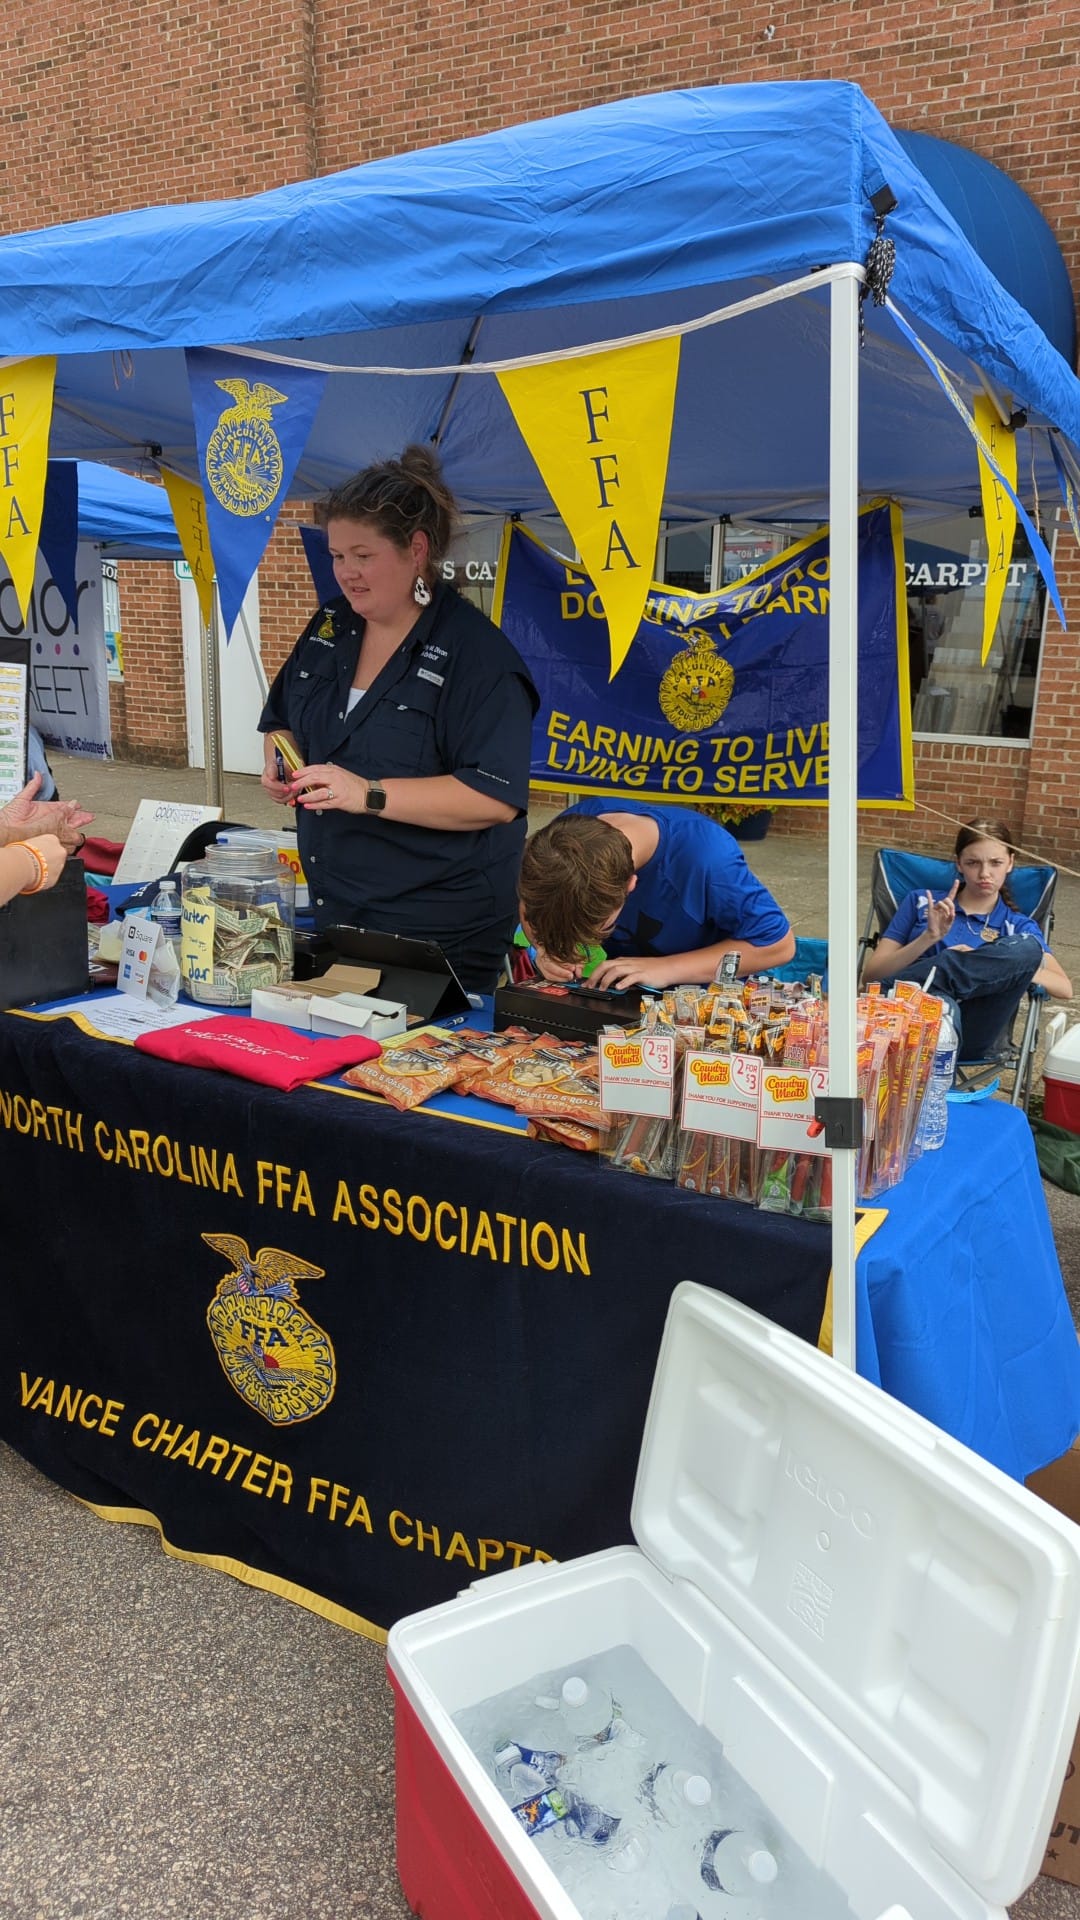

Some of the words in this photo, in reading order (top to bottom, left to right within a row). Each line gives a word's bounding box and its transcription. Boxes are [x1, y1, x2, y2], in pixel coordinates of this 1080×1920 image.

[233, 439, 261, 465] FFA
[0, 393, 32, 539] FFA
[579, 386, 641, 571] FFA
[466, 561, 497, 580] CA
[904, 563, 1026, 586] CARPT
[685, 675, 716, 688] FFA
[547, 711, 700, 764] EARNING
[710, 736, 754, 763] TO
[547, 741, 650, 787] LIVING
[661, 765, 704, 792] TO
[135, 930, 153, 944] Square
[606, 1044, 640, 1057] Country
[648, 1041, 655, 1056] 2
[614, 1054, 640, 1065] Meats
[658, 1054, 668, 1069] $3
[737, 1059, 744, 1076] 2
[746, 1064, 757, 1073] FOR
[692, 1060, 729, 1076] Country
[700, 1073, 727, 1084] Meats
[746, 1074, 757, 1090] $3
[767, 1076, 805, 1092] Country
[817, 1073, 825, 1089] 2
[775, 1088, 805, 1099] Meats
[570, 1097, 600, 1107] ROAST
[727, 1099, 757, 1109] SUPPORTING
[763, 1110, 780, 1118] THANK
[0, 1090, 84, 1153] NORTH
[94, 1120, 244, 1198] CAROLINA
[256, 1160, 317, 1217] FFA
[332, 1180, 592, 1276] ASSOCIATION
[224, 1303, 312, 1352] AGRICULTURAL
[240, 1319, 289, 1348] FFA
[18, 1371, 126, 1437] VANCE
[131, 1412, 294, 1504] CHARTER
[306, 1476, 375, 1534] FFA
